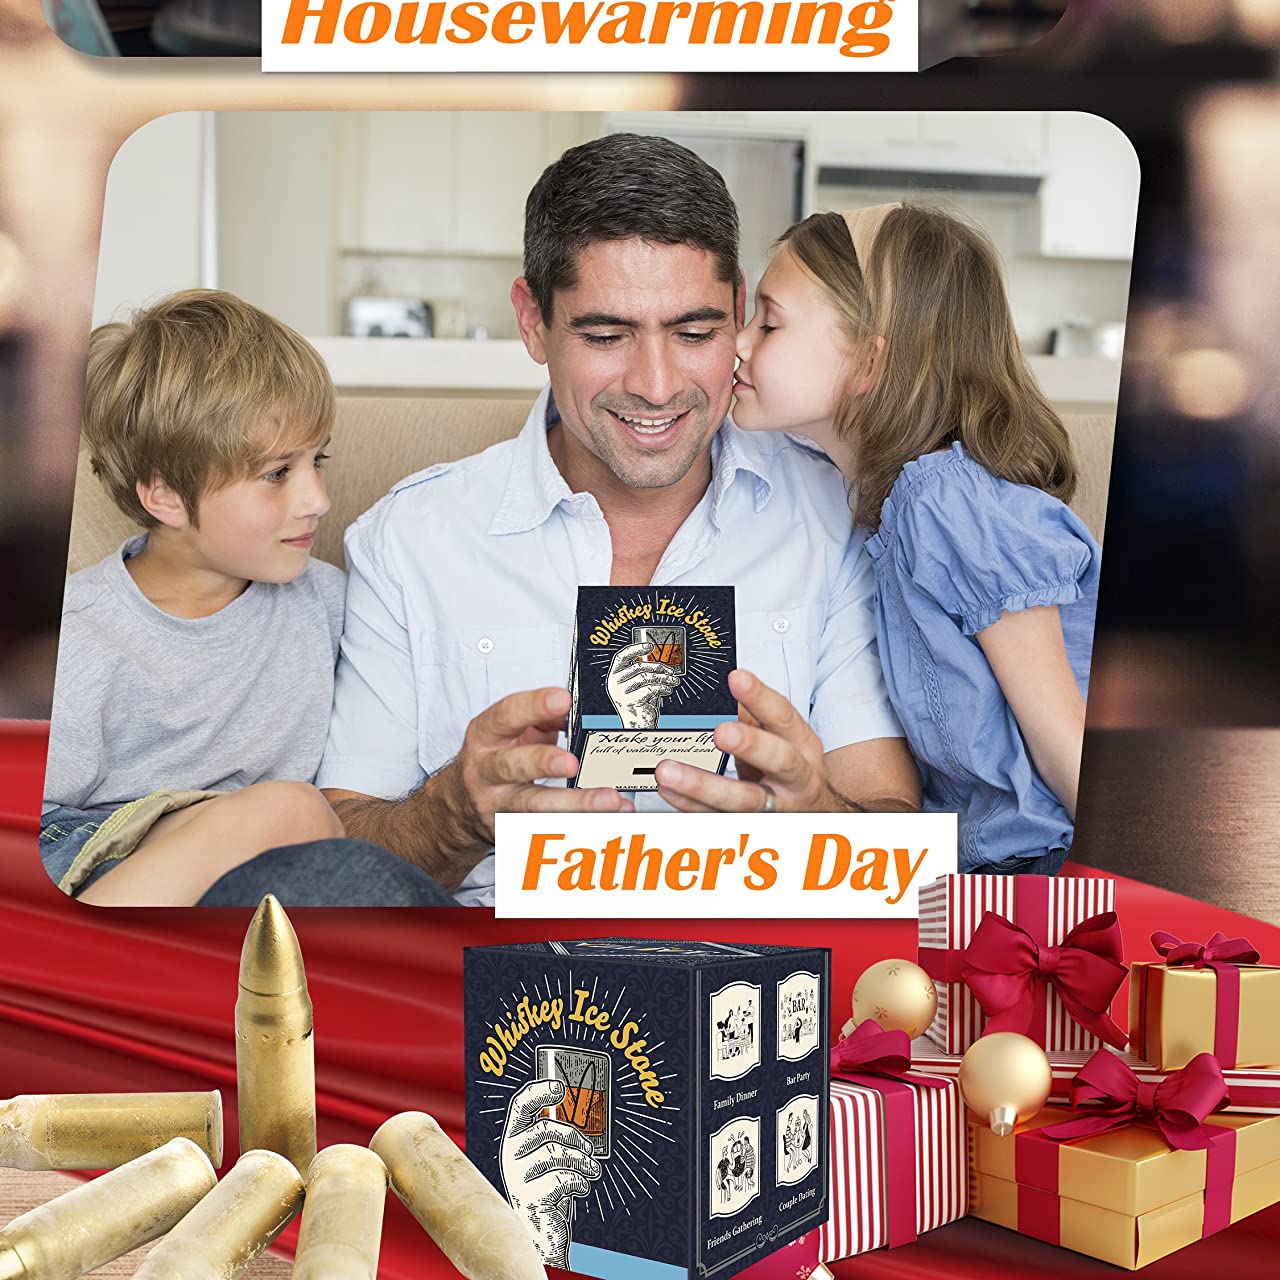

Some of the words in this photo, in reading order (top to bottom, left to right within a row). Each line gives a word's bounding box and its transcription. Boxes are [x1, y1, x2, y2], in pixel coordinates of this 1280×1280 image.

[589, 603, 653, 646] Whiskey
[656, 598, 685, 617] Ice
[685, 610, 721, 648] Stone
[590, 746, 612, 755] full
[612, 746, 624, 755] of
[669, 746, 695, 754] and
[598, 732, 646, 744] Make
[646, 735, 692, 747] your
[792, 998, 806, 1013] BAR
[479, 994, 564, 1078] Whiskey
[568, 988, 612, 1031] Ice
[609, 1021, 666, 1109] Stone
[786, 1075, 796, 1086] Bar
[796, 1071, 811, 1083] Party
[713, 1095, 735, 1111] Family
[736, 1088, 758, 1103] Dinner
[778, 1196, 798, 1212] Couple
[798, 1187, 817, 1202] Dating
[706, 1234, 732, 1250] Friends
[732, 1215, 763, 1236] Gathering
